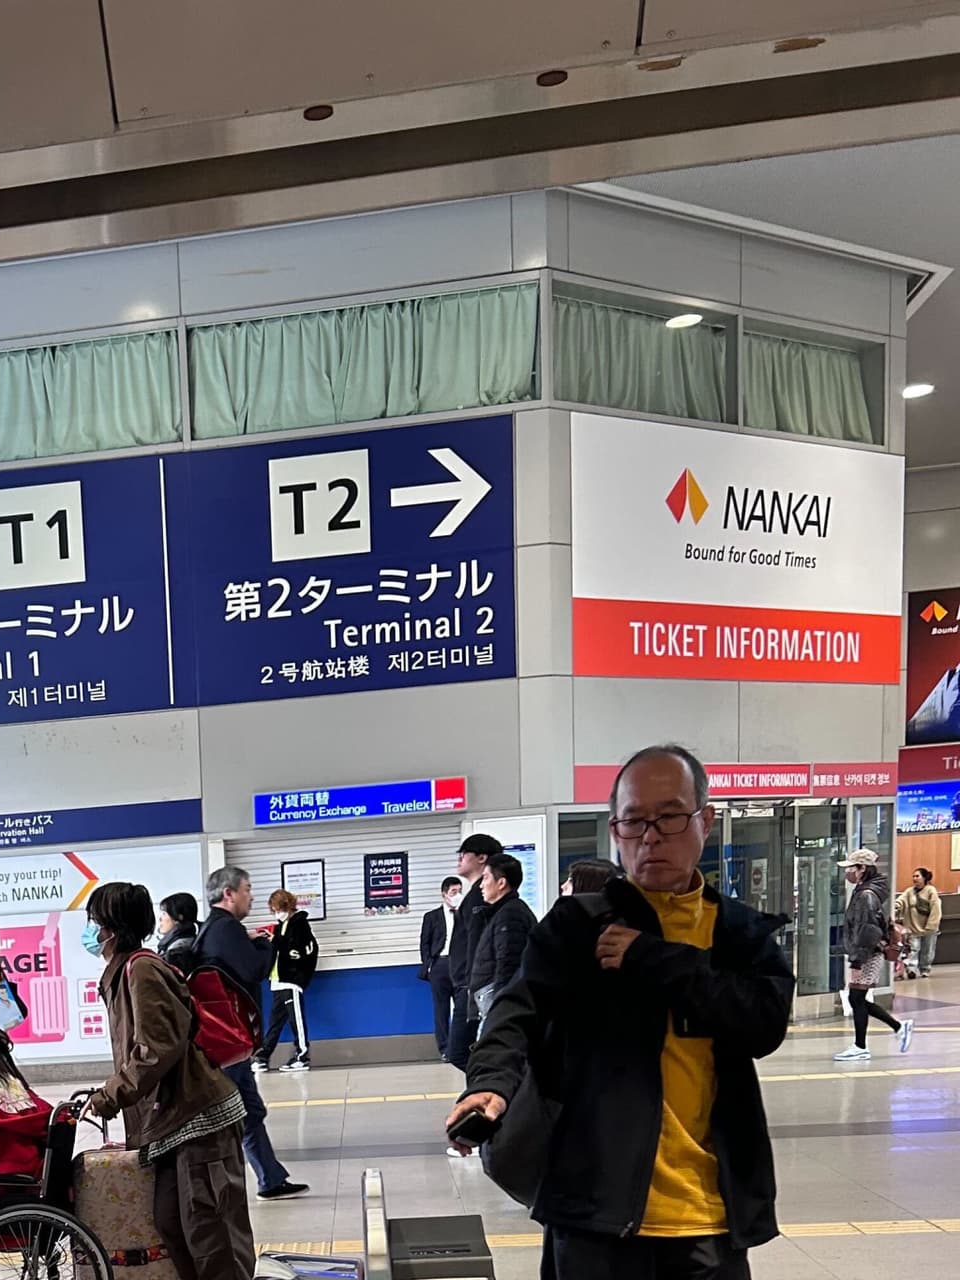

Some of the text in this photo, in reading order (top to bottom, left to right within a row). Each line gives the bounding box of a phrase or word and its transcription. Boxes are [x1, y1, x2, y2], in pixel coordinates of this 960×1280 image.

[279, 478, 361, 535] T2
[722, 486, 832, 538] NANKAI
[685, 543, 817, 569] Bound for Good Times
[223, 559, 494, 622] 第2ターミナル
[324, 606, 495, 649] Terminal 2
[931, 624, 959, 635] Bound
[629, 621, 860, 663] TICKET INFORMATION
[28, 651, 40, 677] 1
[260, 643, 494, 685] 2号航站楼 제2터미널
[8, 680, 107, 708] 제1터미널
[942, 756, 960, 770] Ti
[707, 772, 807, 788] ANKAI TICKET INFORMATION
[269, 791, 329, 809] 外貨両替
[269, 806, 316, 822] Currency
[319, 803, 367, 817] Exchange
[381, 799, 430, 814] Travelex
[29, 826, 44, 835] Hall
[901, 820, 947, 832] Welcome
[13, 870, 37, 883] your
[40, 868, 62, 881] trip!
[11, 884, 63, 901] NANKAI
